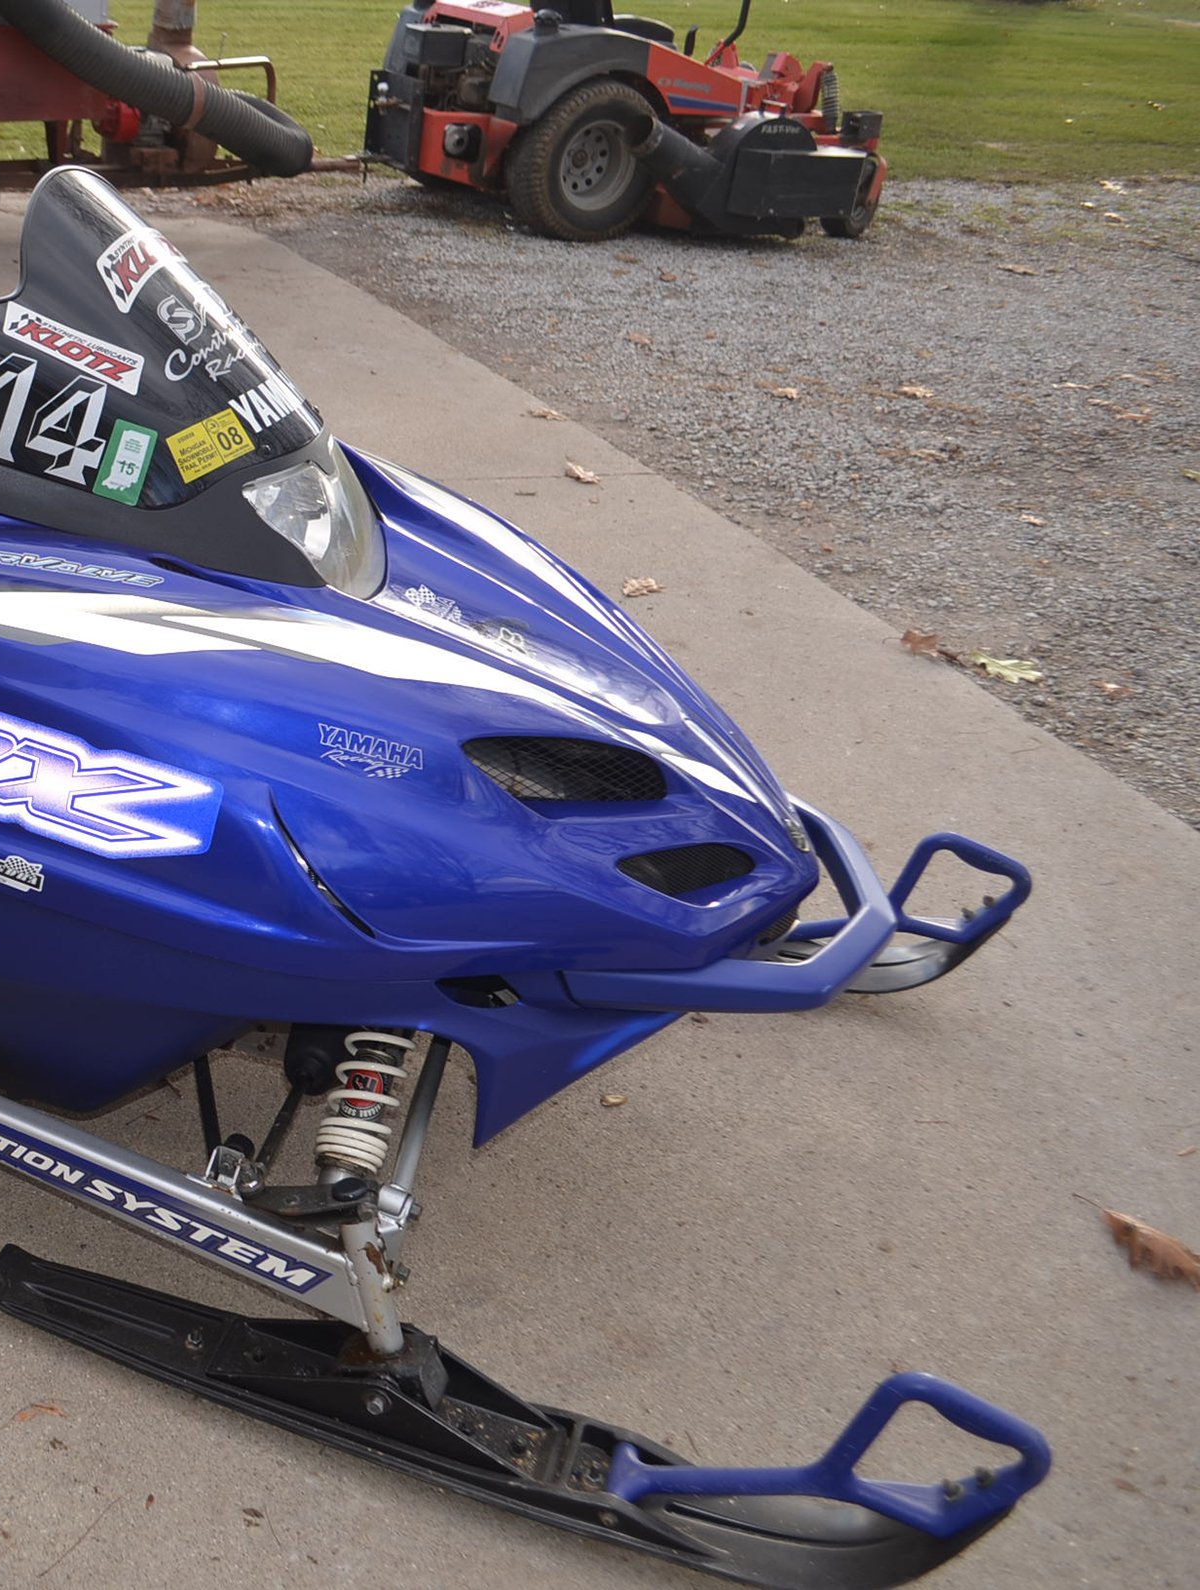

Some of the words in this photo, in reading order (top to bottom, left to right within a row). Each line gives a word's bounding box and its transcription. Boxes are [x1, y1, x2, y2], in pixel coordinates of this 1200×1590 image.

[16, 319, 137, 381] KLOTZ
[217, 427, 243, 451] 08
[118, 460, 136, 475] 15
[318, 723, 423, 770] YAMAHA
[85, 1178, 317, 1288] SYSTEM
